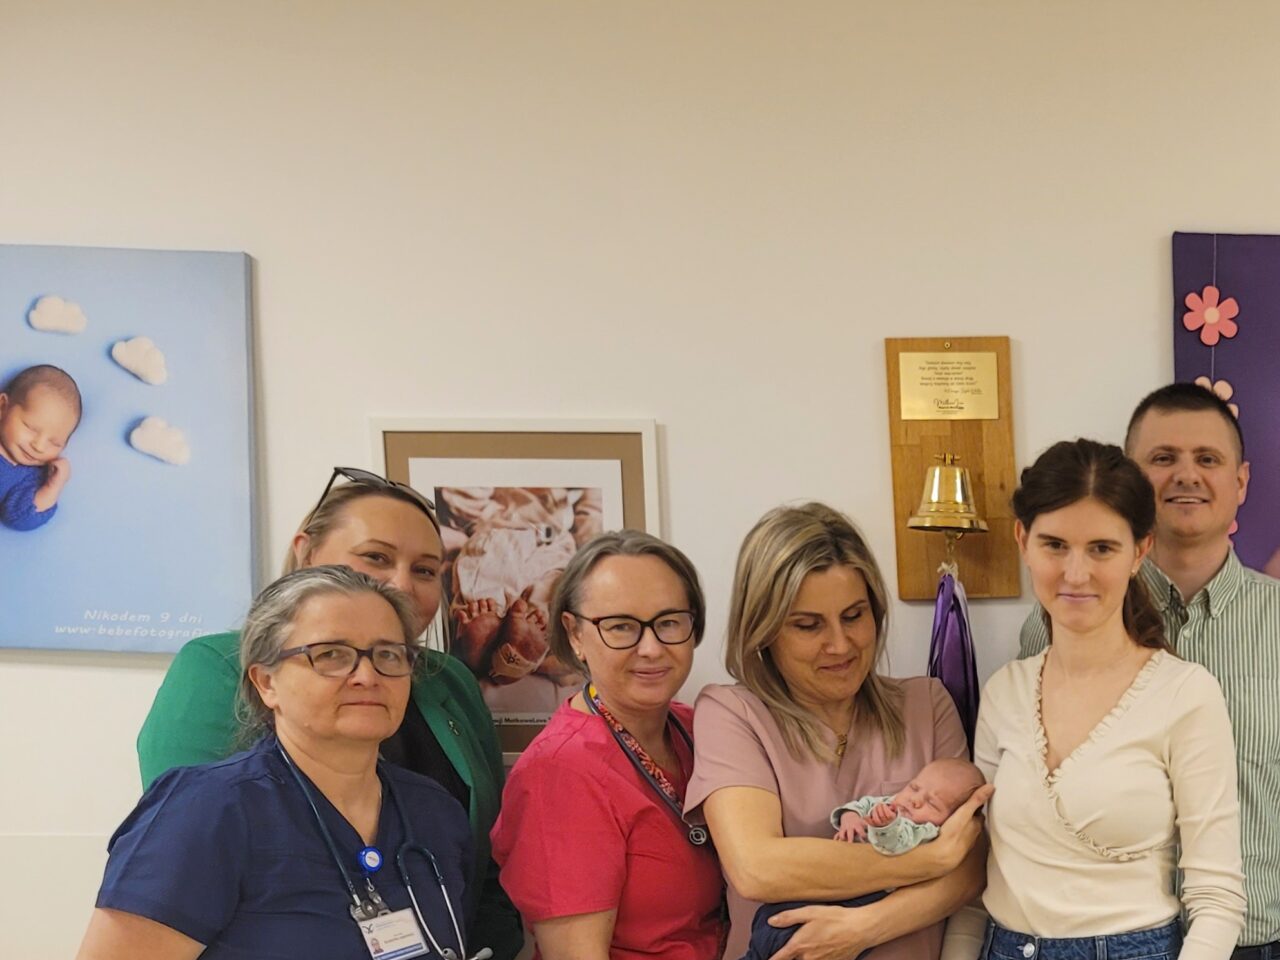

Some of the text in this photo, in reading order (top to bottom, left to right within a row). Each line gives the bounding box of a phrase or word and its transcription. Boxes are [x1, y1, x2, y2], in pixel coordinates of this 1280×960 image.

[84, 609, 203, 625] Nikodem 9 dni
[54, 624, 210, 640] www.bebefotografi
